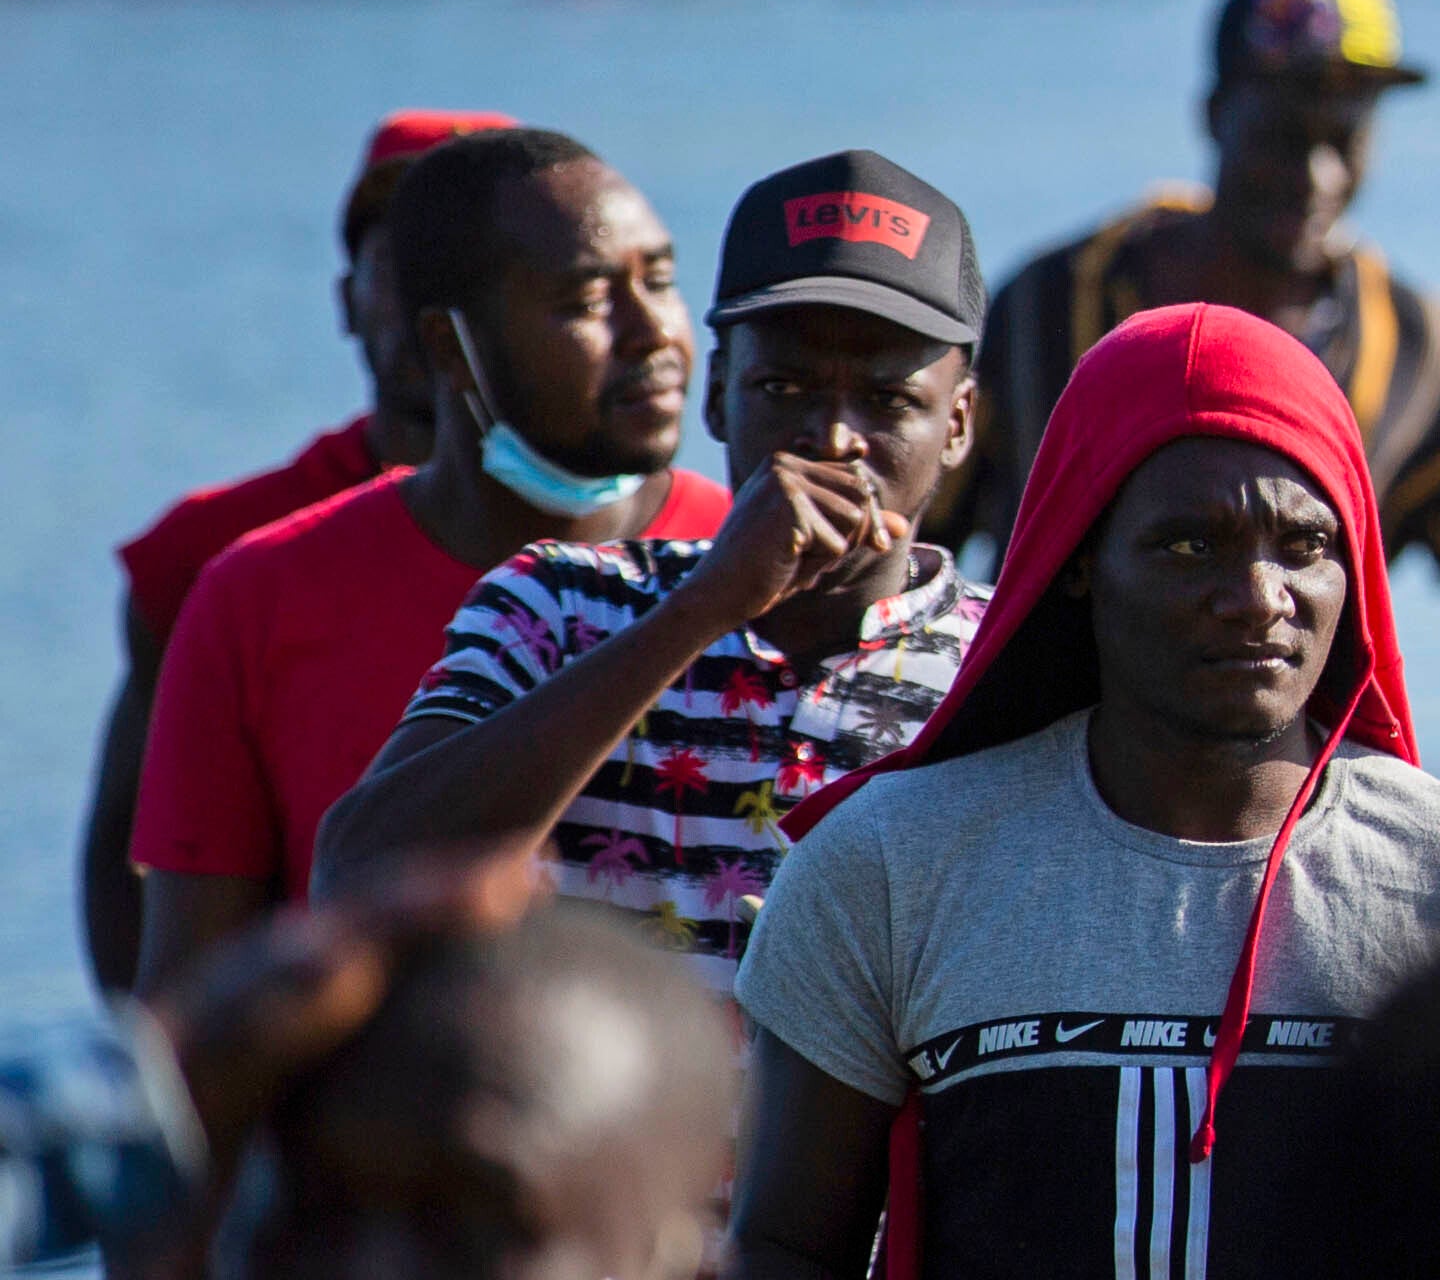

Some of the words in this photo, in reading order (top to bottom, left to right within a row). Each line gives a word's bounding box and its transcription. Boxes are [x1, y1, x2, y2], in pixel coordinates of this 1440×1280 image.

[978, 1021, 1040, 1055] NIKE
[1120, 1021, 1188, 1047] NIKE
[1265, 1021, 1335, 1047] NIKE
